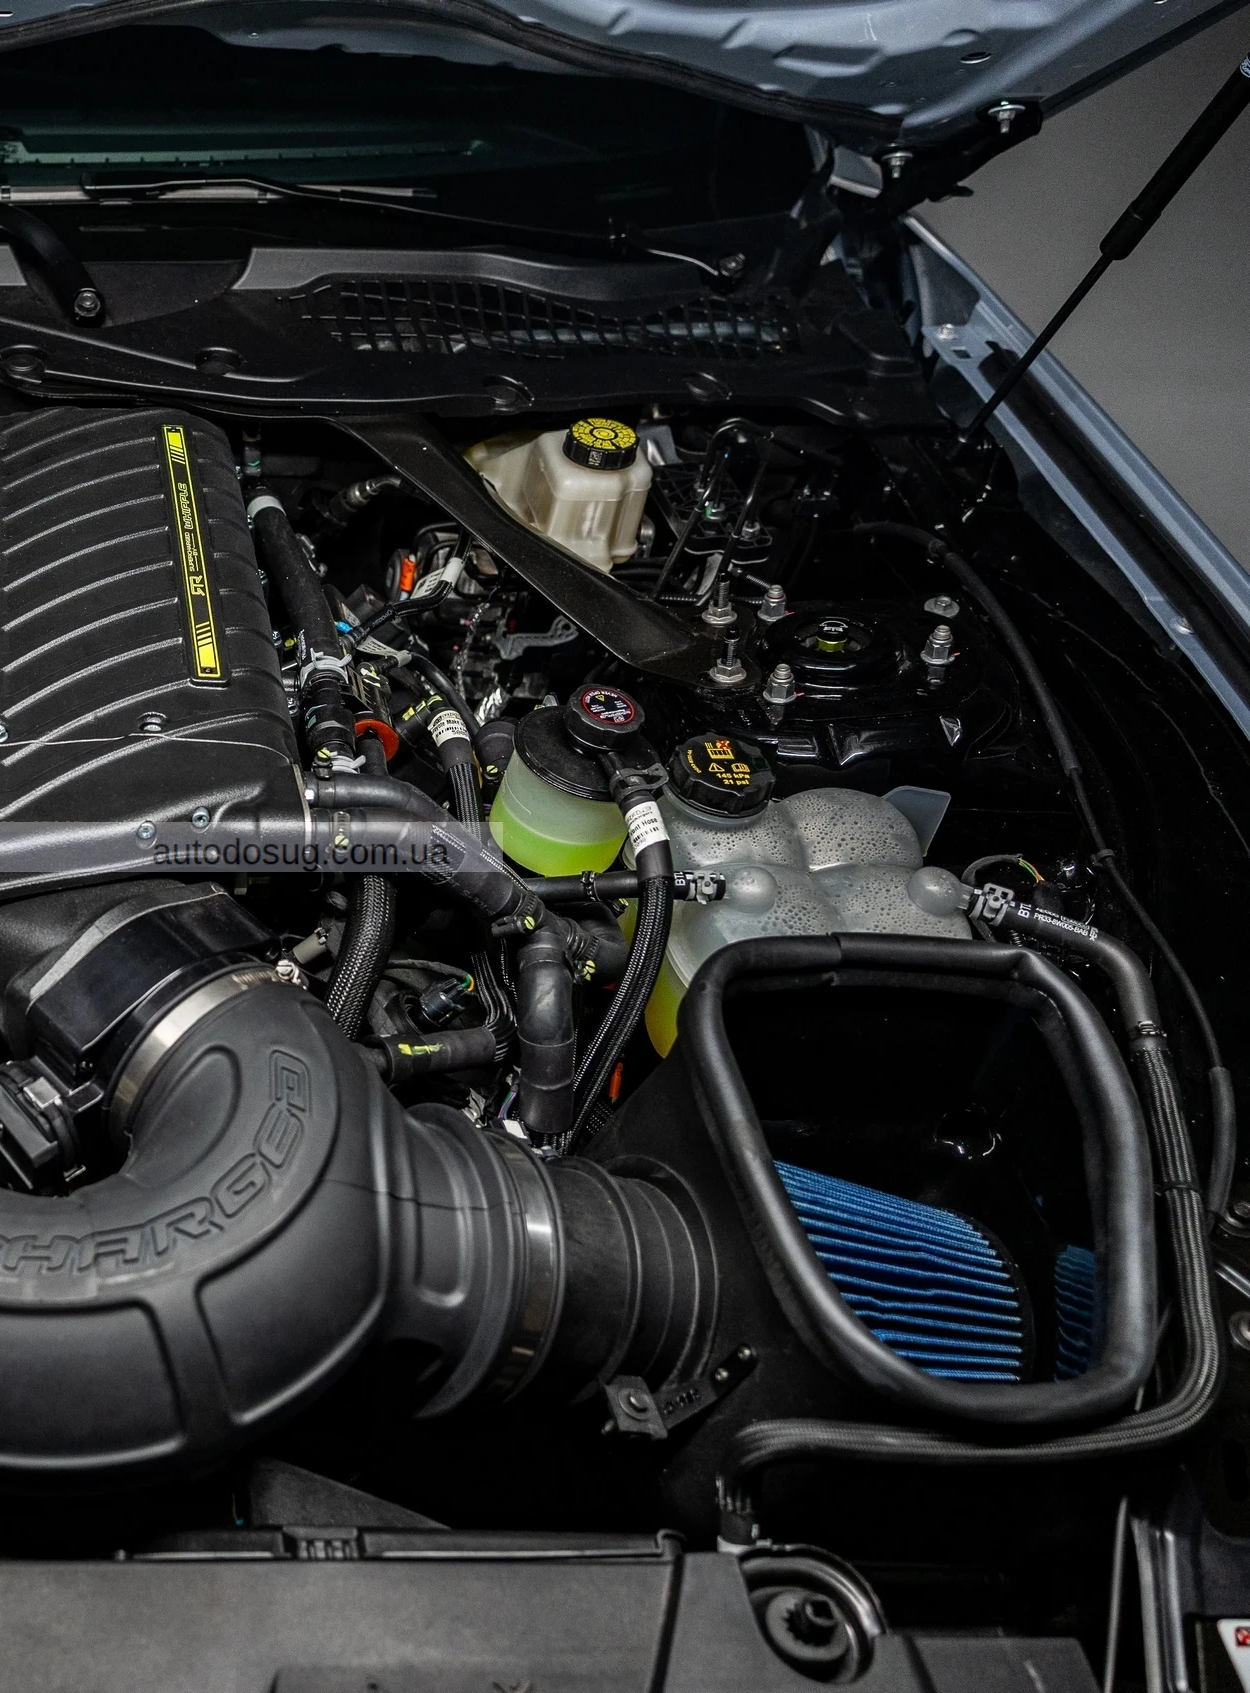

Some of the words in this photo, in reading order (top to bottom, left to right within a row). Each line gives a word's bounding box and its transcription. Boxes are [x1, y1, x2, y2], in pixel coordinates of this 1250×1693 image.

[177, 482, 194, 530] WHIPPLE
[184, 532, 194, 572] SUPERCHARGED
[642, 817, 658, 827] Hose
